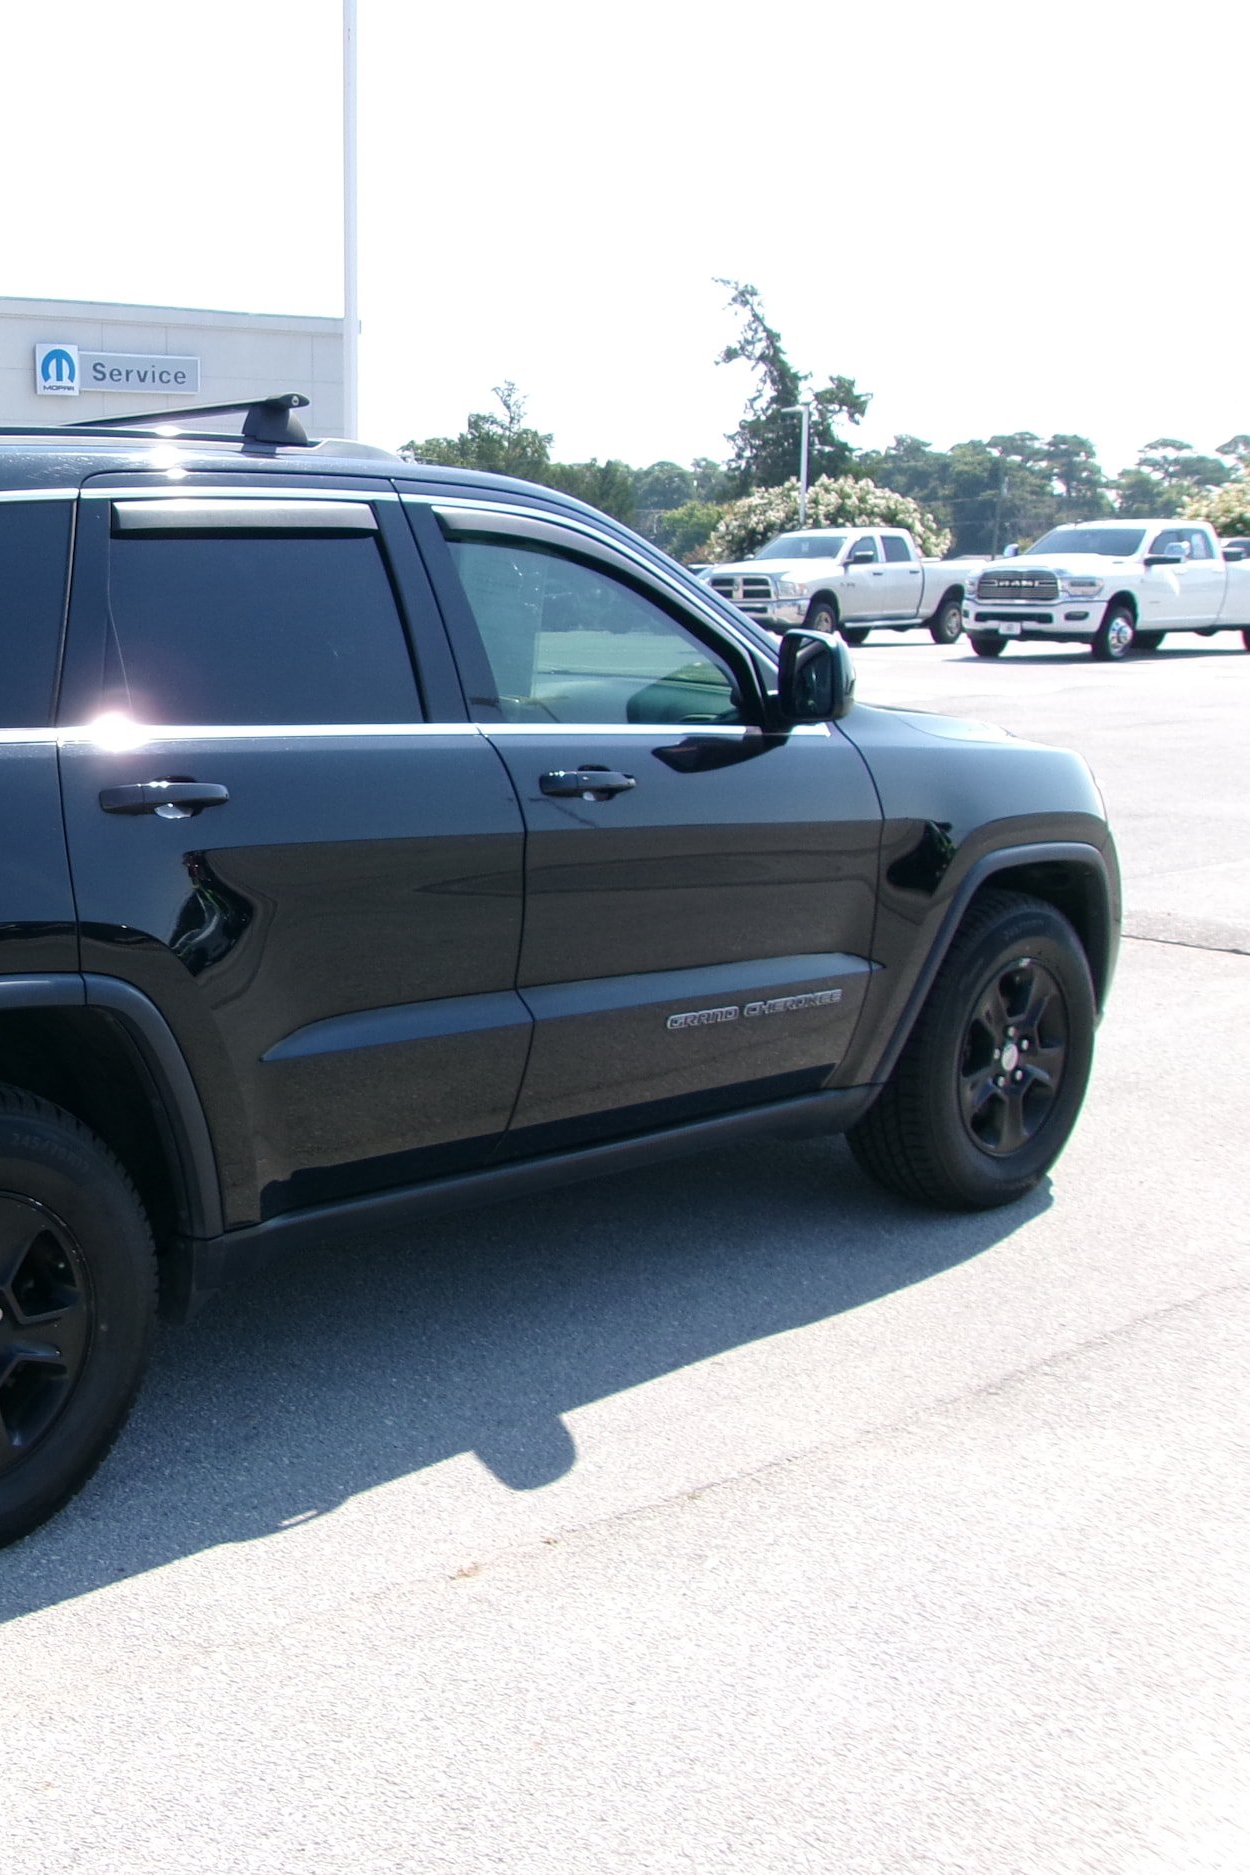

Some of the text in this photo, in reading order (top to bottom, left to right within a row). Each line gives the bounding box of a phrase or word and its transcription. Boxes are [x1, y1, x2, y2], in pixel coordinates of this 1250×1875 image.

[92, 362, 187, 385] Service
[666, 989, 843, 1030] GRAND CHEROKEE
